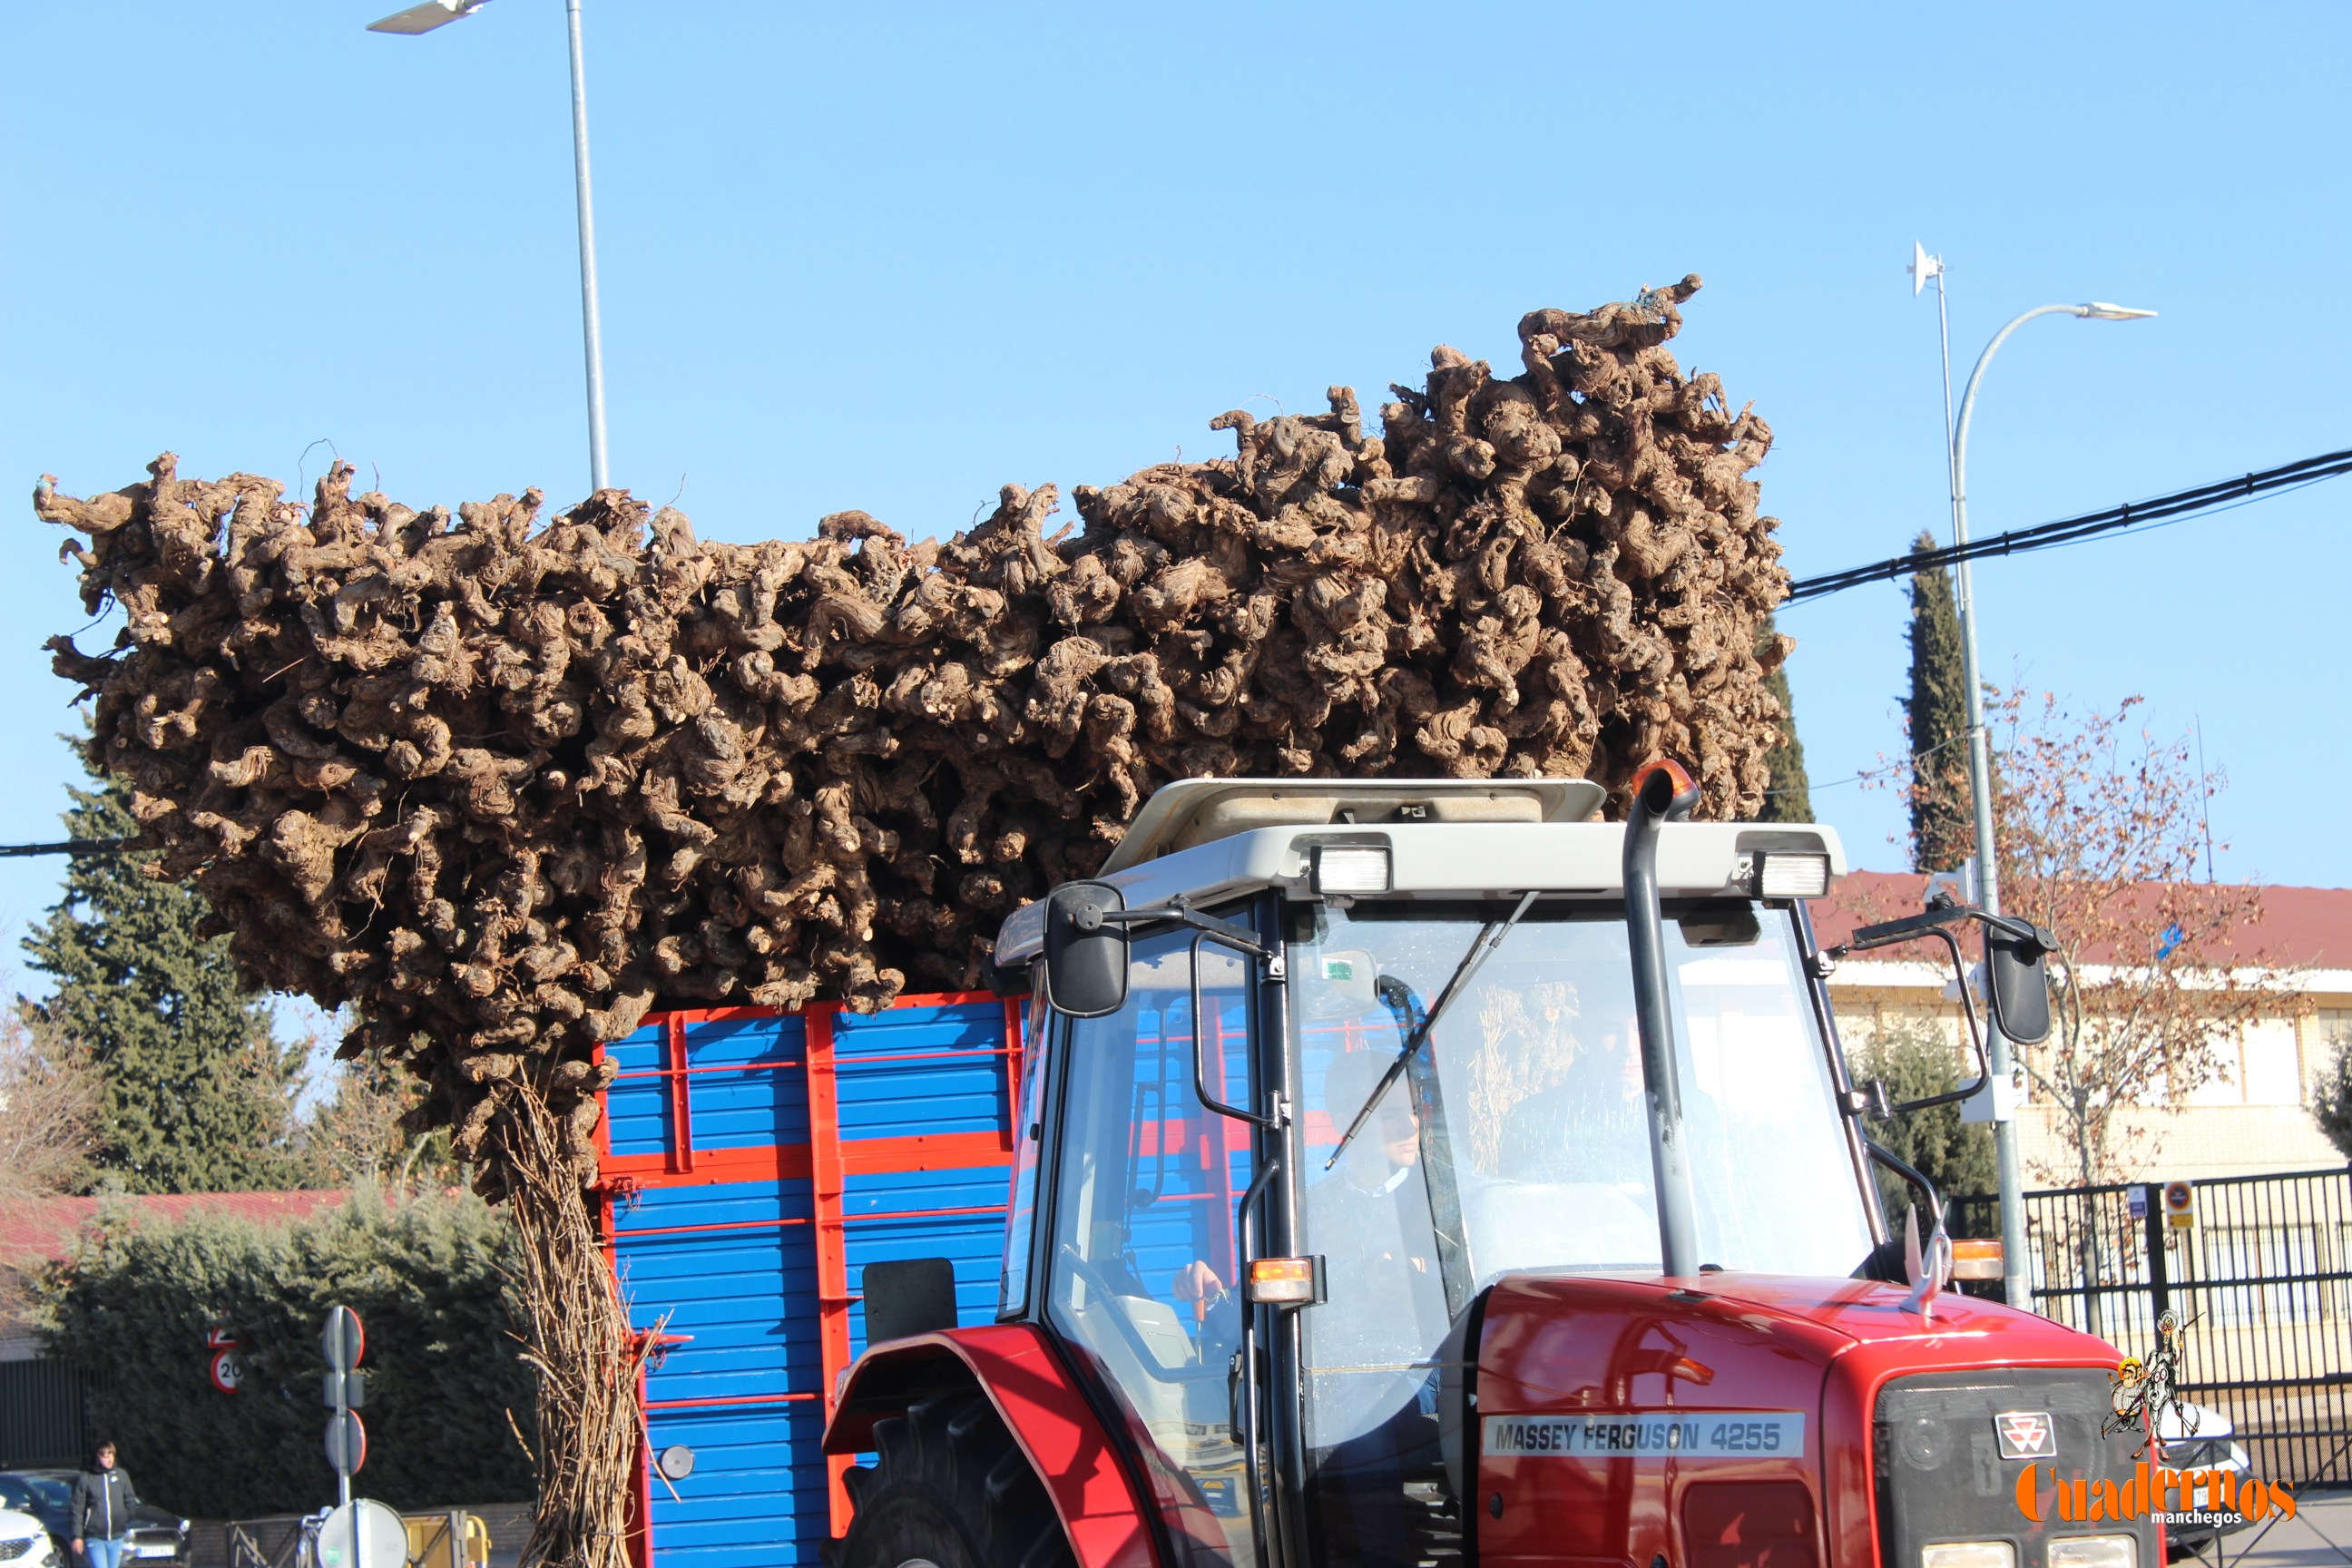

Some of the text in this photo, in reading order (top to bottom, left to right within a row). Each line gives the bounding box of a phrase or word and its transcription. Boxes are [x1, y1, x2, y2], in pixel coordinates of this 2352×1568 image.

[221, 1363, 241, 1377] 20
[1496, 1423, 1780, 1450] MASSEY FERGUSON 4255
